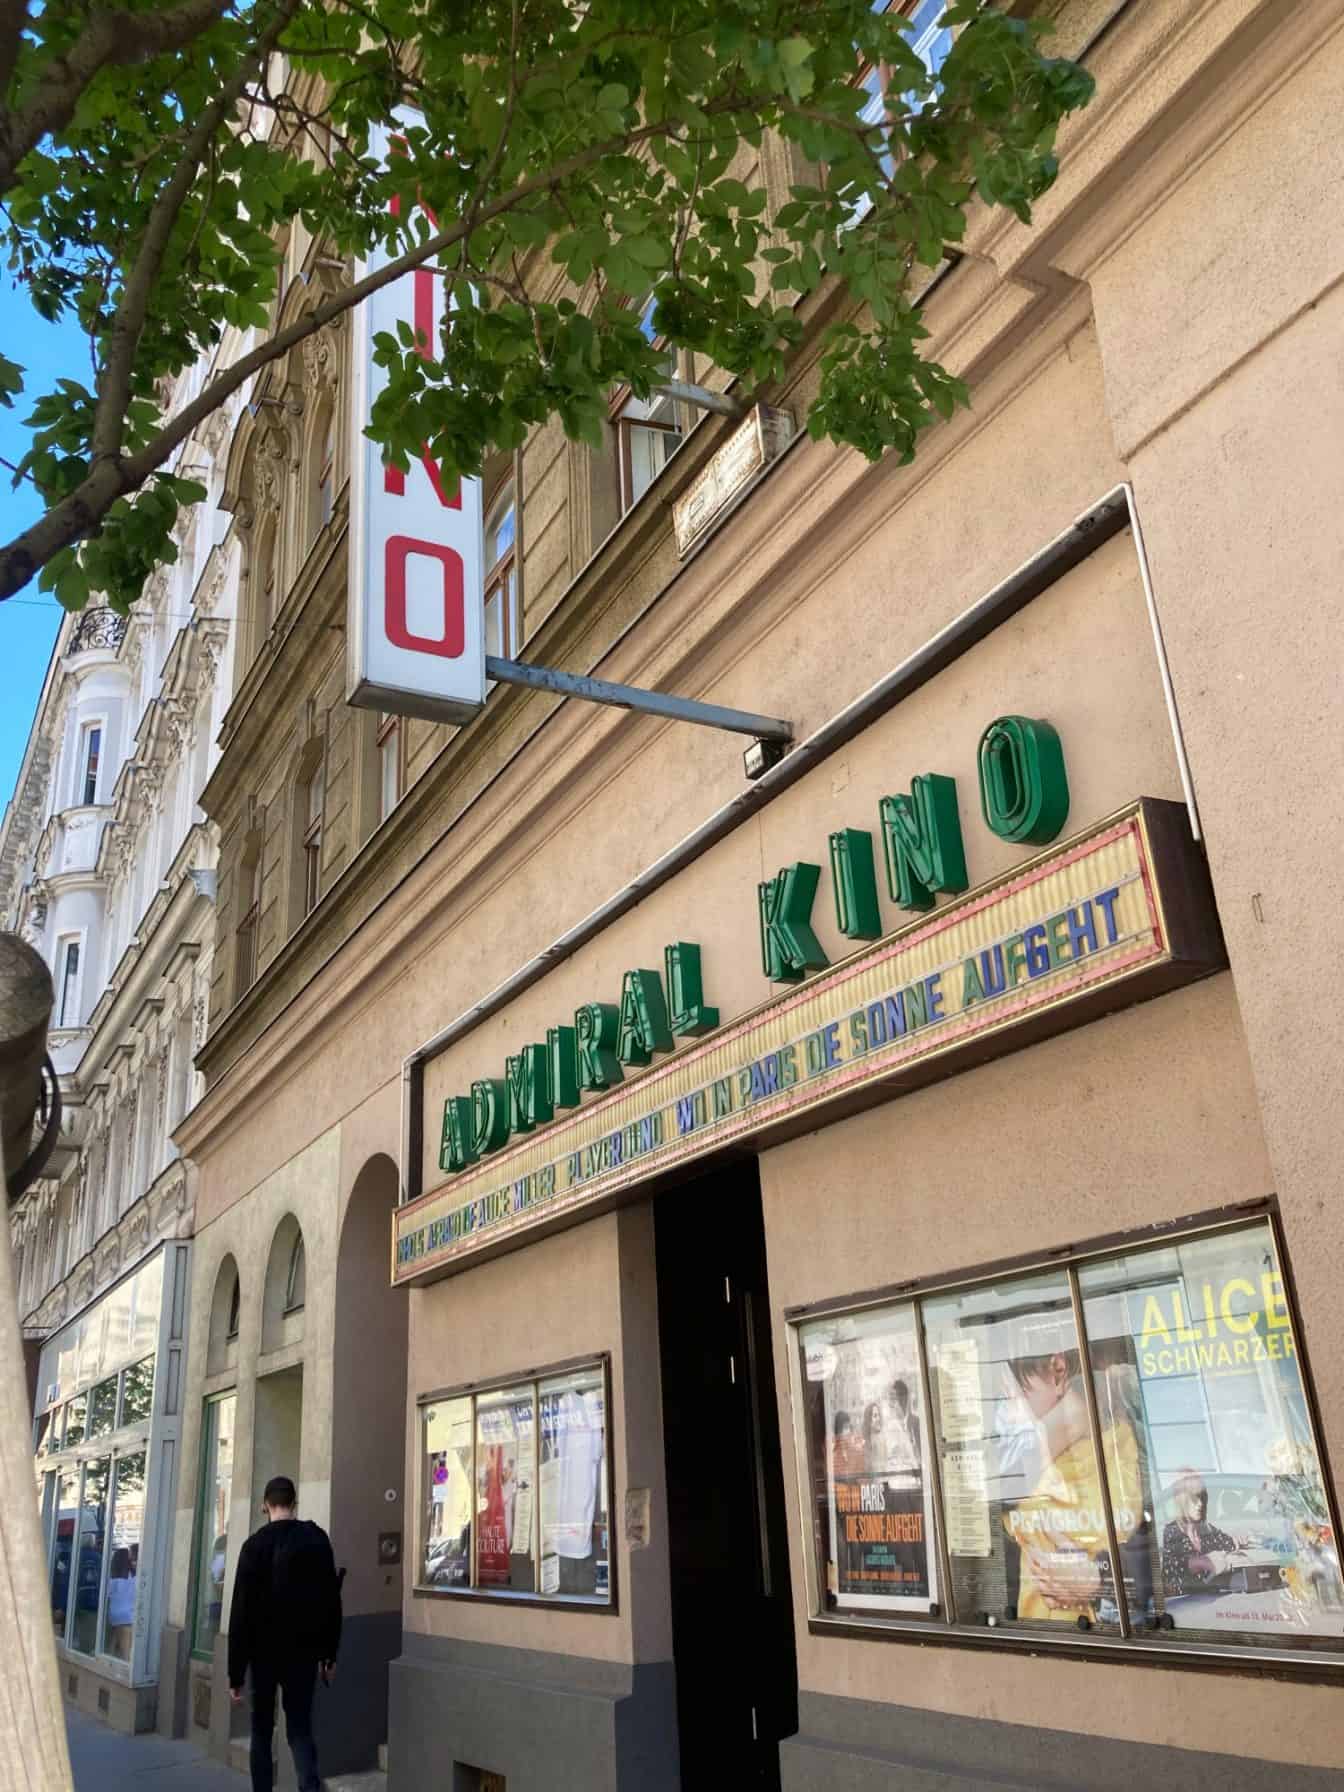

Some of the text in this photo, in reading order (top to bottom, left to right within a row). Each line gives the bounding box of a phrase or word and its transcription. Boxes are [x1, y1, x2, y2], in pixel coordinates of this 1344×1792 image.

[439, 714, 1070, 1173] ADMIRAL KINO
[513, 1162, 555, 1212] MILLER
[567, 1111, 664, 1186] PLAYGROUND
[676, 1091, 707, 1135] WO
[711, 1076, 733, 1121] IN
[737, 1045, 798, 1109] PARIS
[806, 1022, 843, 1077] DIE
[850, 972, 945, 1058] SONNE
[962, 887, 1120, 1007] AUFGEHT
[1140, 1271, 1290, 1349] ALICE
[860, 1483, 886, 1512] PARIS
[886, 1512, 922, 1543] AUFGEHT
